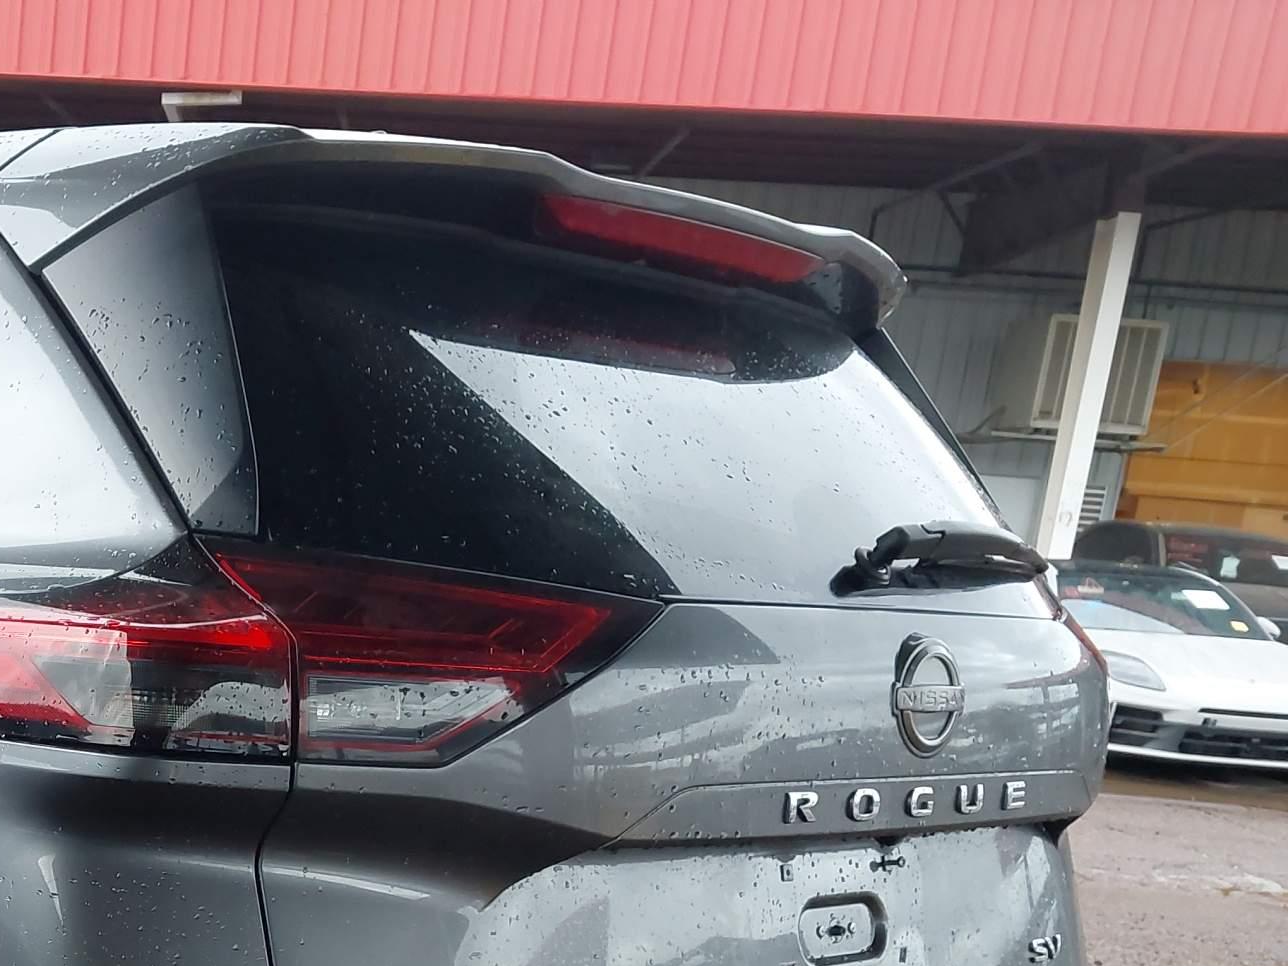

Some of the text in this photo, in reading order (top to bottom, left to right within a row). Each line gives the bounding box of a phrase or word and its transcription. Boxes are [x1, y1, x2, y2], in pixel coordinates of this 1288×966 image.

[900, 689, 964, 707] NISSAN
[783, 780, 1027, 824] ROGUE
[1028, 933, 1062, 963] SV
